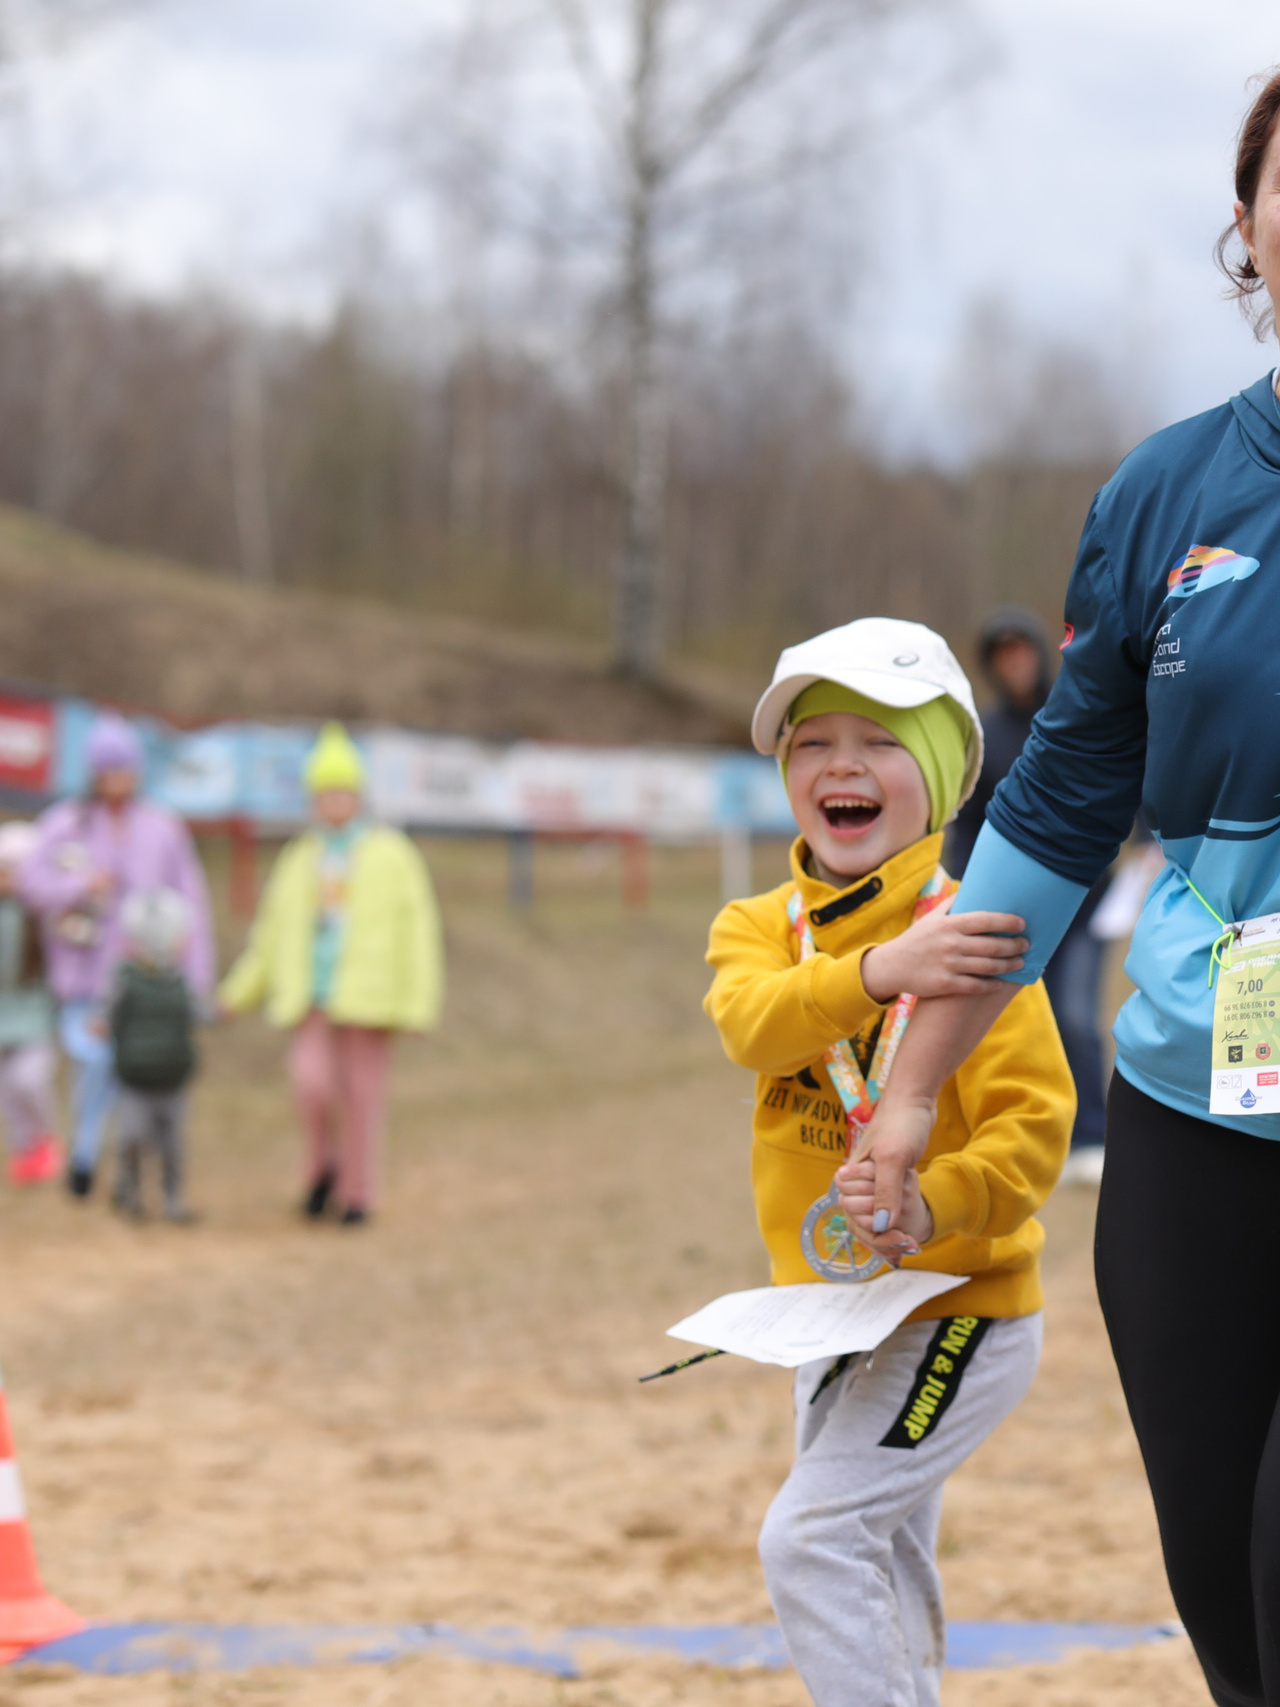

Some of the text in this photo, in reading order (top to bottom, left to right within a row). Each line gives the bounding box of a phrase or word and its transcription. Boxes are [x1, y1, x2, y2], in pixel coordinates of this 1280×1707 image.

[1154, 637, 1180, 657] and
[1236, 978, 1264, 996] 7,00
[764, 1087, 789, 1110] LET
[903, 1315, 979, 1440] RUN & JUMP
